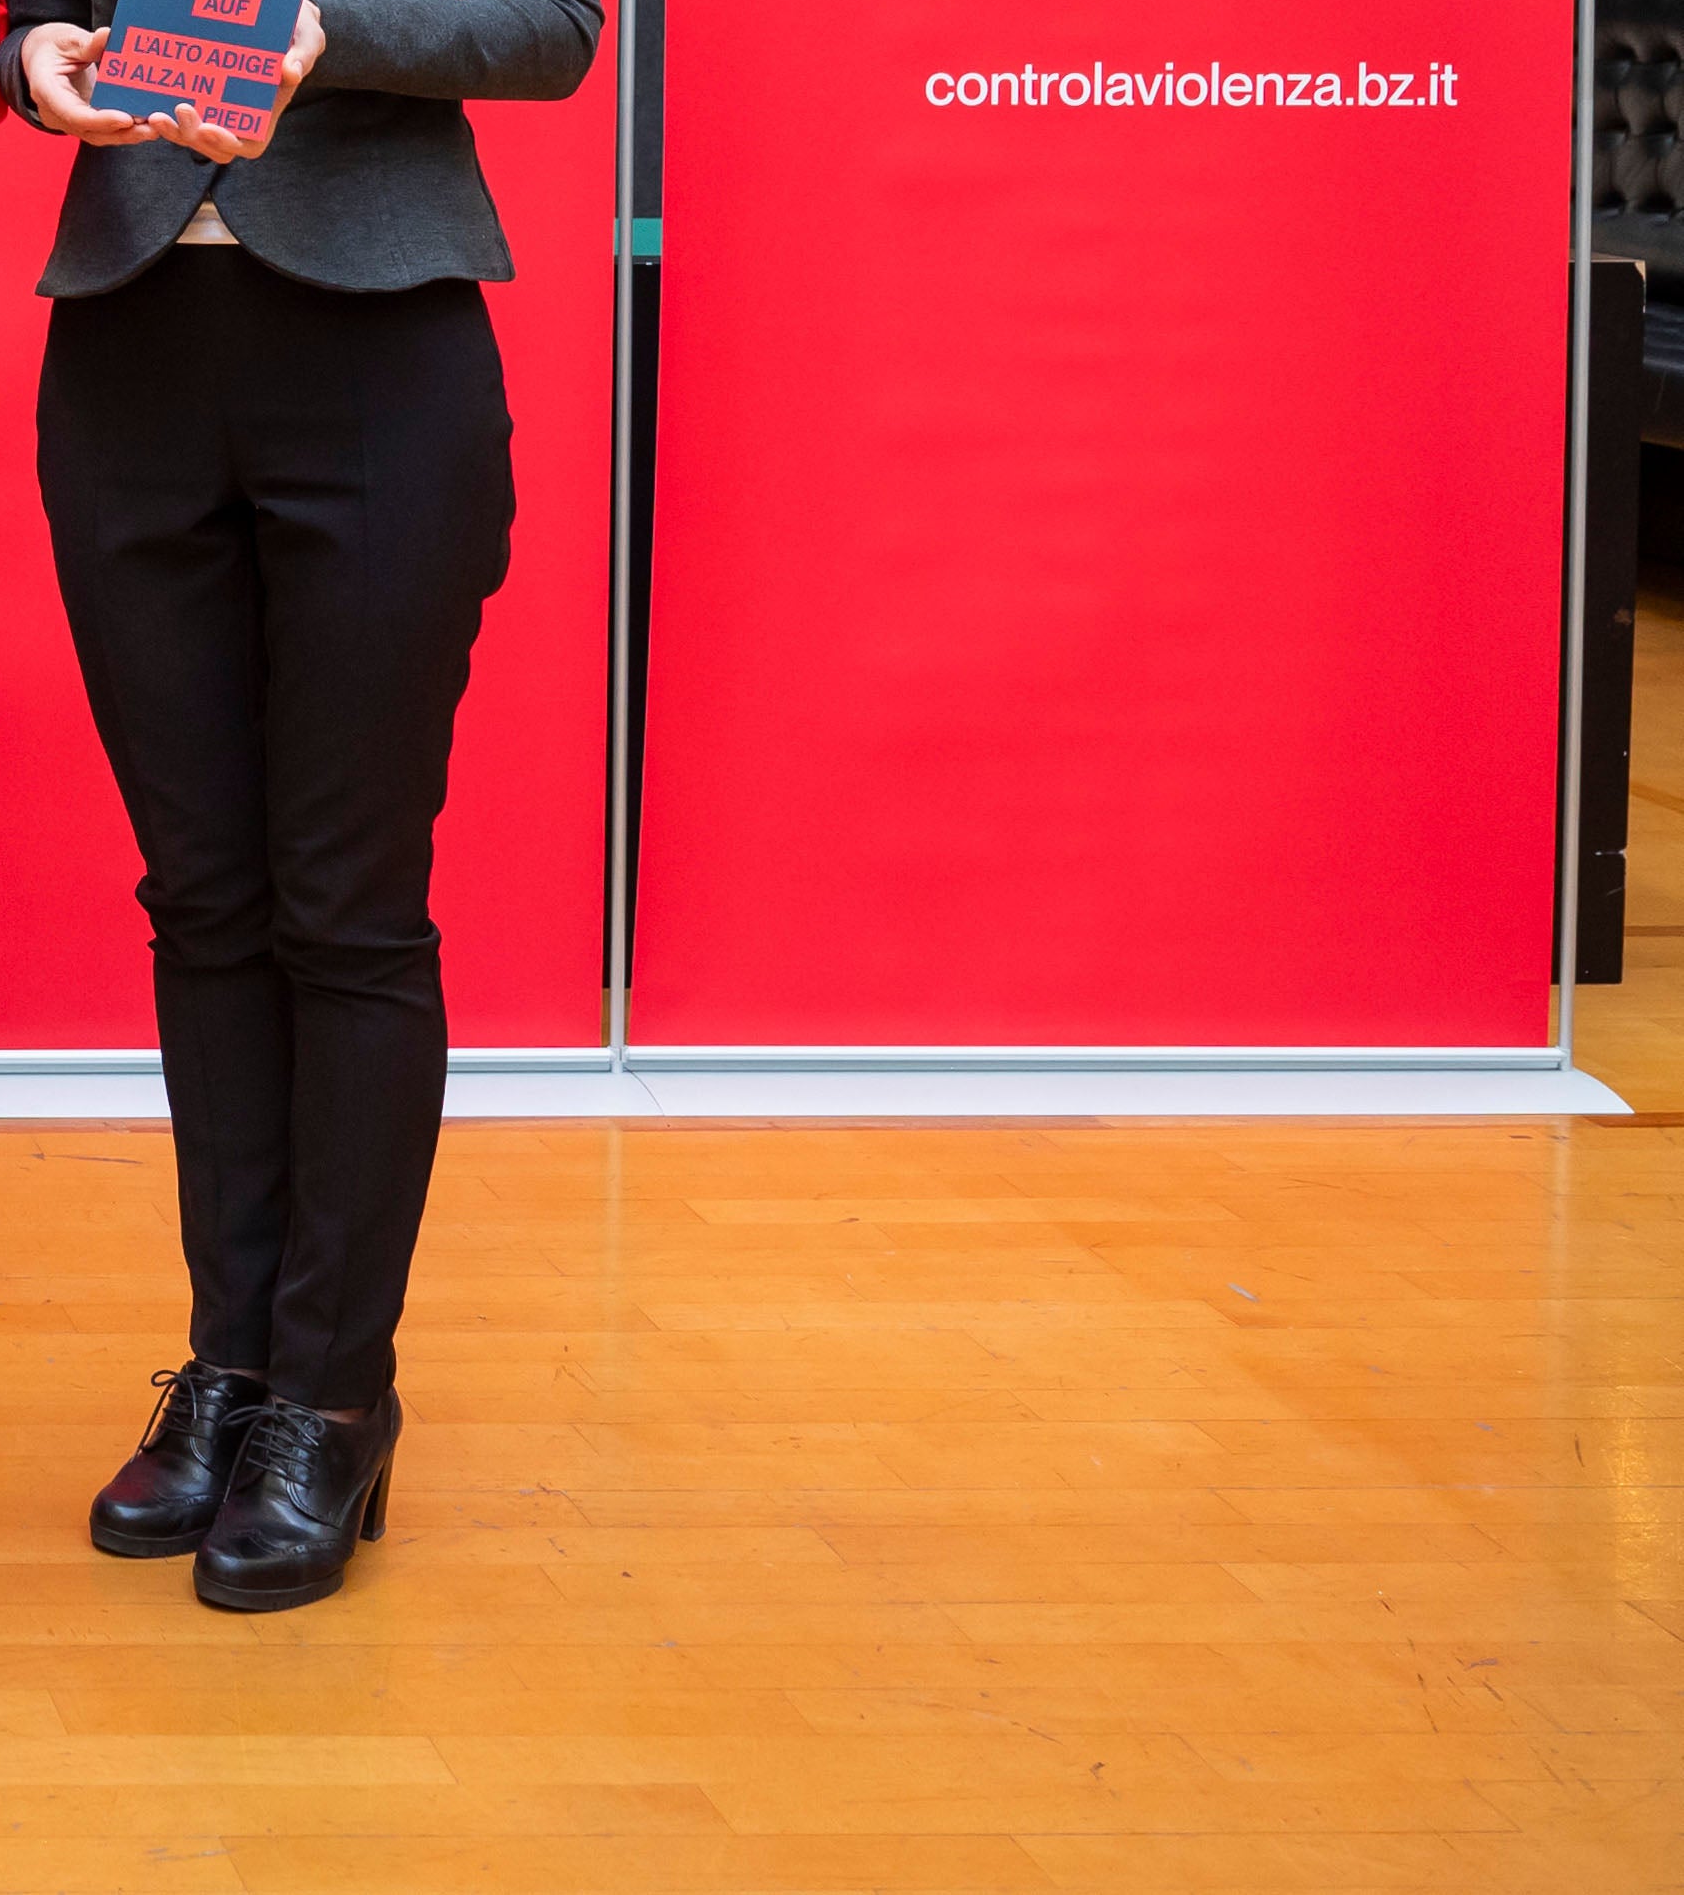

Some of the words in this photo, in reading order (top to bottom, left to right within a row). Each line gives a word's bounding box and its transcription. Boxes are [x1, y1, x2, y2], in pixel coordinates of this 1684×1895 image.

[134, 34, 202, 62] L'ALTO
[204, 49, 278, 77] ADIGE
[105, 59, 128, 78] SI
[130, 63, 187, 90] ALZA
[190, 74, 216, 96] IN
[924, 61, 1459, 108] controlaviolenza.bz.it
[202, 106, 262, 134] PIEDI
